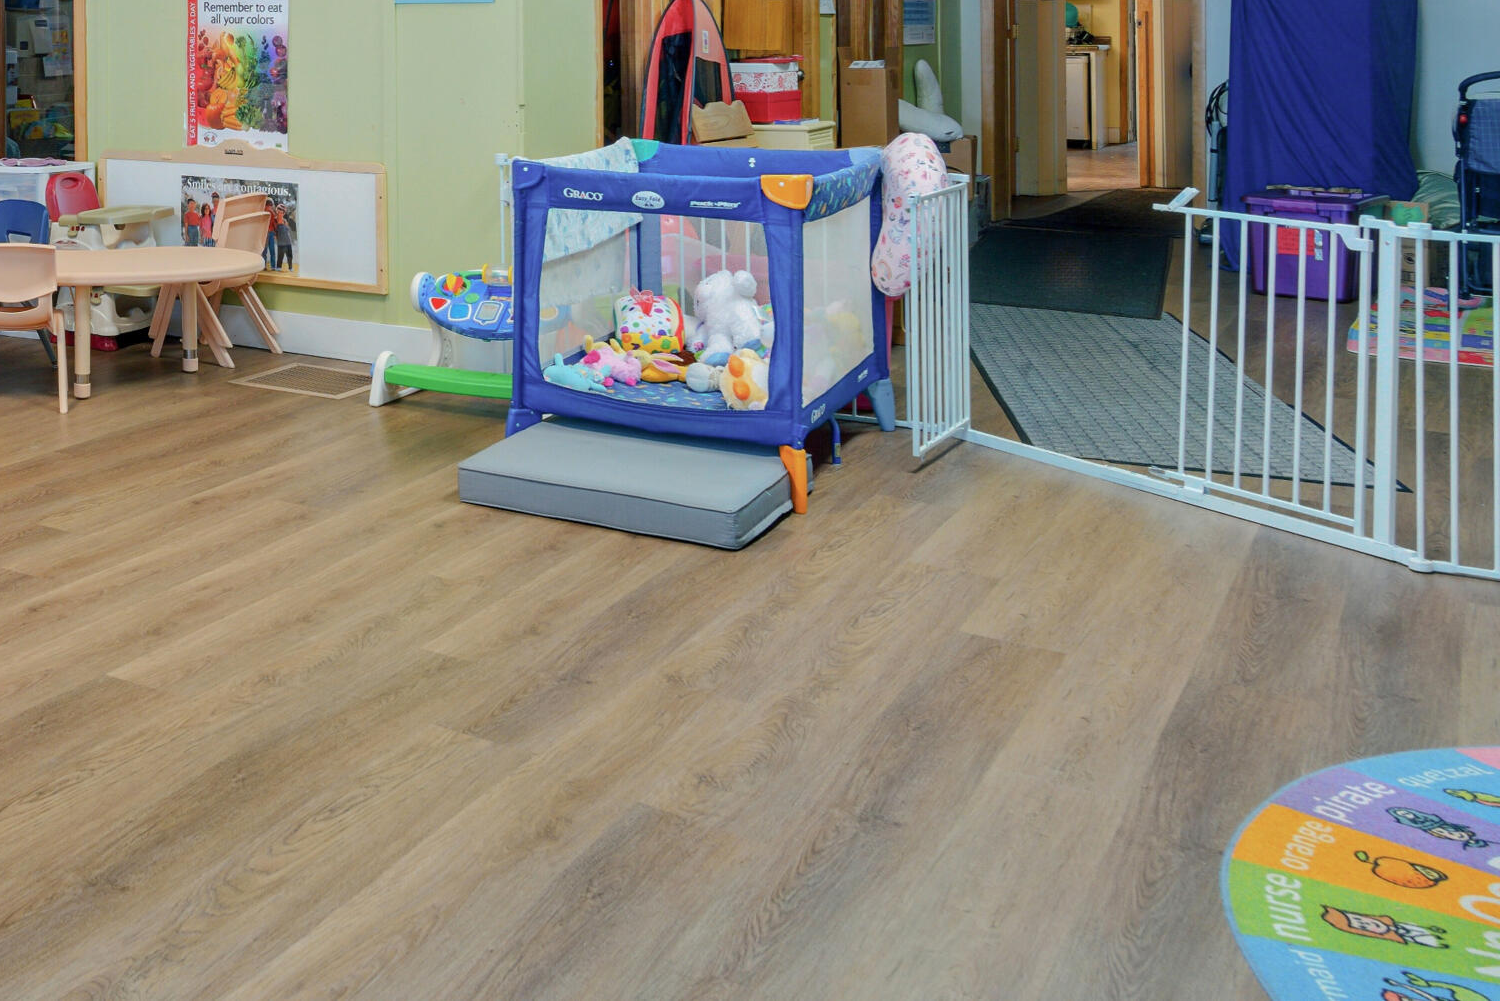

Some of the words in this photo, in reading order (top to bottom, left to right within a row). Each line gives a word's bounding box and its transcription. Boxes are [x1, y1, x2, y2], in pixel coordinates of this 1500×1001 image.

[203, 1, 254, 13] Remember
[256, 3, 266, 13] to
[268, 3, 282, 13] eat
[210, 14, 221, 24] all
[223, 15, 244, 27] your
[246, 13, 275, 25] colors
[187, 178, 216, 190] Smiles
[235, 182, 292, 197] contagious.
[563, 187, 603, 201] GRACO
[1397, 763, 1495, 789] quetzal
[1312, 780, 1397, 824] pirate
[1279, 820, 1336, 872] orange
[1265, 872, 1313, 942] nurse
[1288, 947, 1350, 1001] maid
